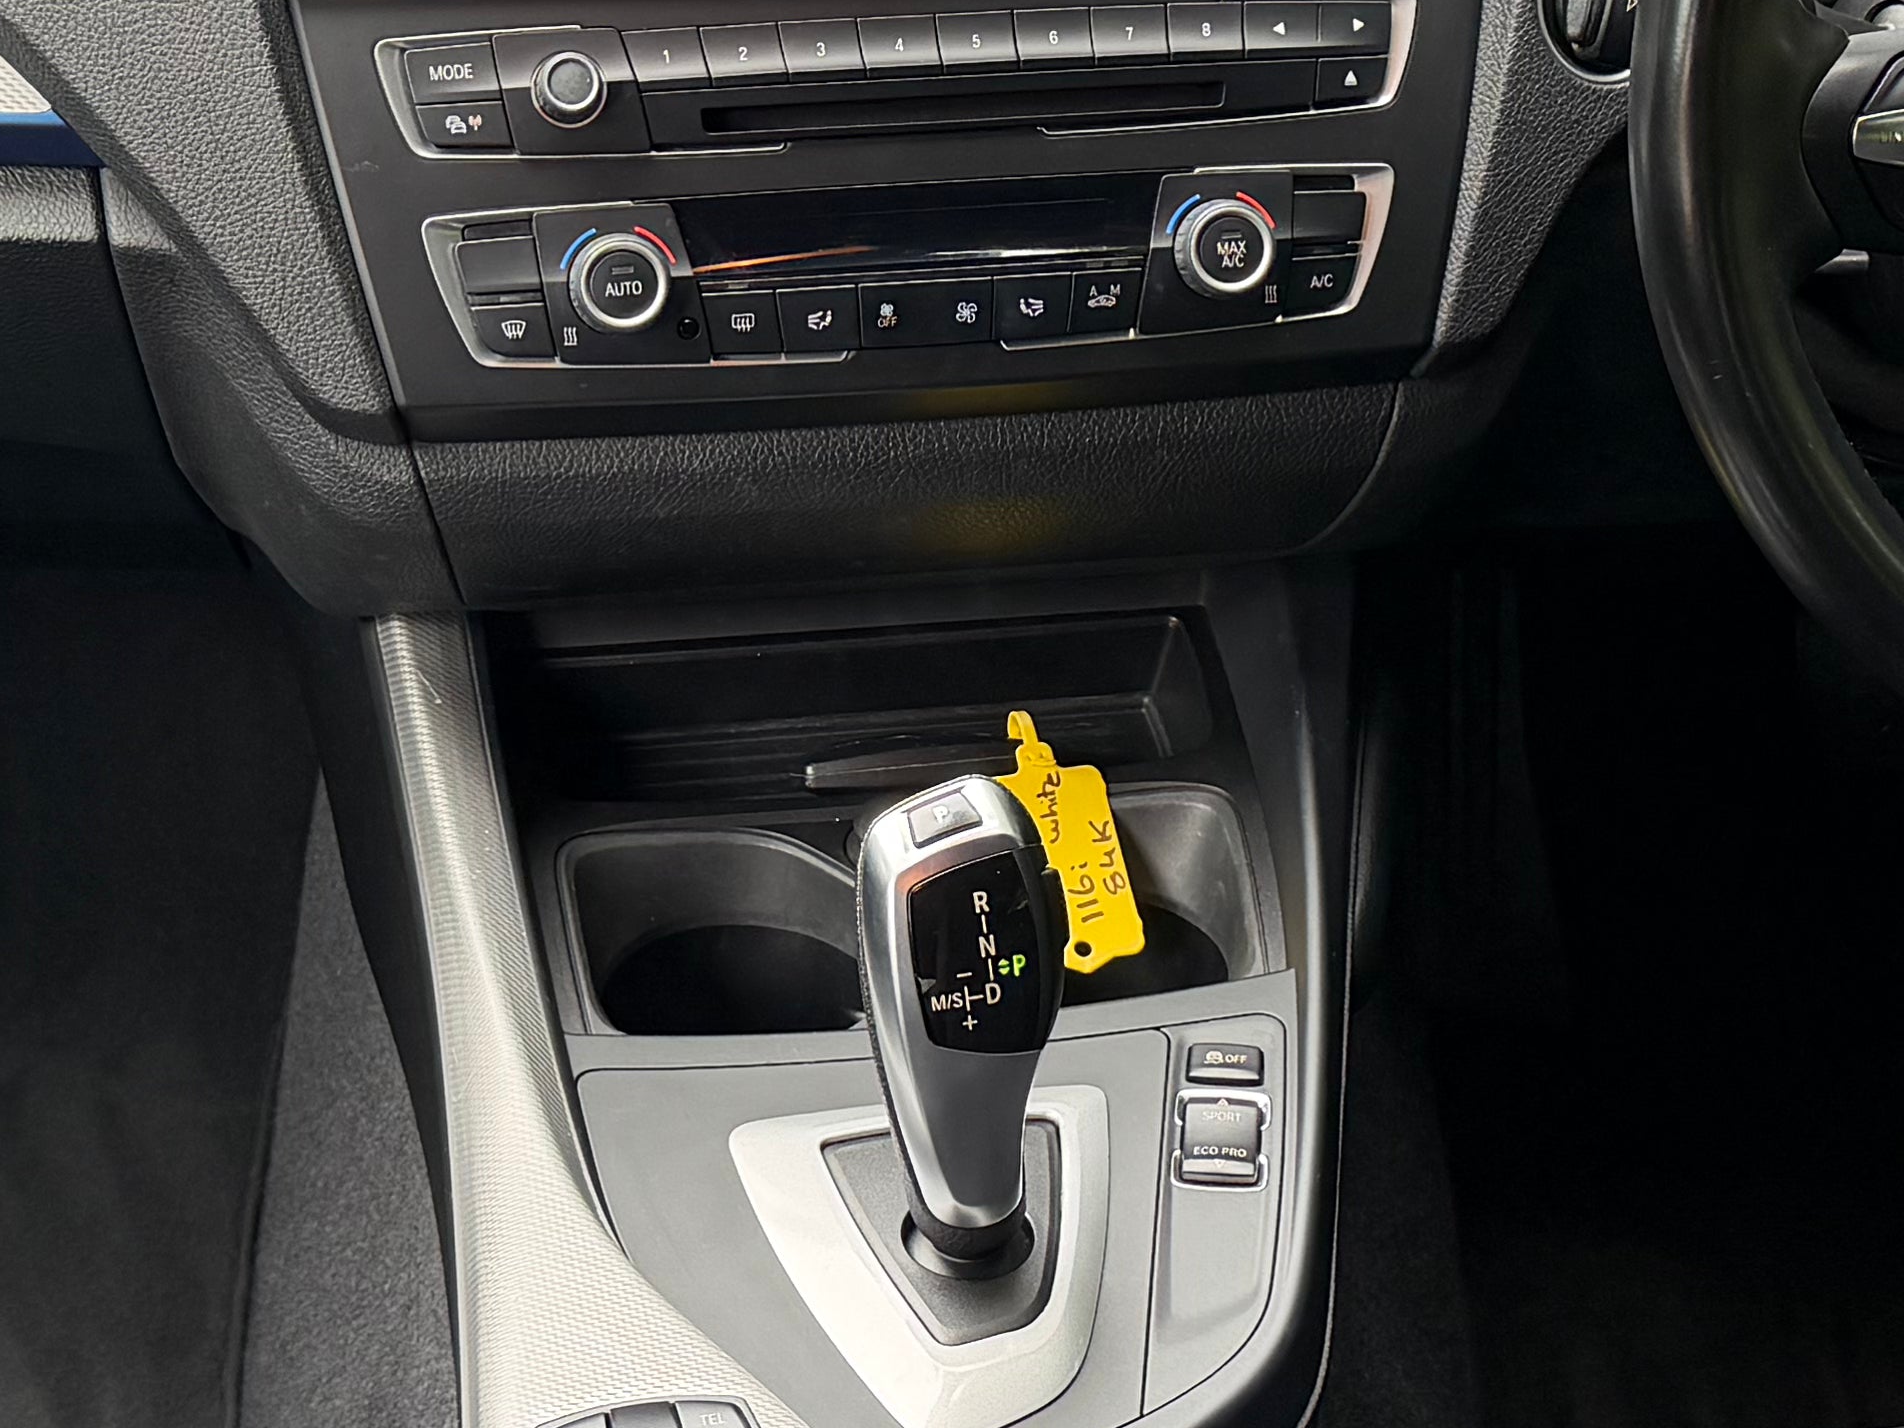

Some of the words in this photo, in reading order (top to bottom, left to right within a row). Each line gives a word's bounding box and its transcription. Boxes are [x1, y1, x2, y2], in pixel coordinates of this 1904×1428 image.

[1125, 27, 1134, 41] 7
[1202, 22, 1211, 37] 8
[895, 38, 904, 52] 4
[972, 34, 981, 49] 5
[1049, 30, 1058, 45] 6
[663, 49, 669, 64] 1
[739, 47, 748, 61] 2
[816, 42, 826, 57] 3
[429, 63, 474, 81] MODE
[1216, 240, 1247, 256] MAX
[1221, 253, 1245, 269] A/C
[605, 280, 643, 298] AUTO
[1310, 274, 1334, 289] A/C
[877, 315, 898, 327] OFF
[931, 804, 950, 824] P
[1036, 770, 1061, 844] white
[1067, 861, 1105, 923] 116i
[973, 891, 990, 914] R
[978, 934, 996, 958] N
[1012, 953, 1026, 977] P
[985, 983, 1001, 1005] D
[930, 992, 964, 1012] M/S
[1225, 1054, 1247, 1064] OFF
[1202, 1110, 1242, 1123] SPORT
[1193, 1146, 1218, 1156] ECO
[1221, 1147, 1247, 1158] PRO
[700, 1412, 726, 1426] TEL
